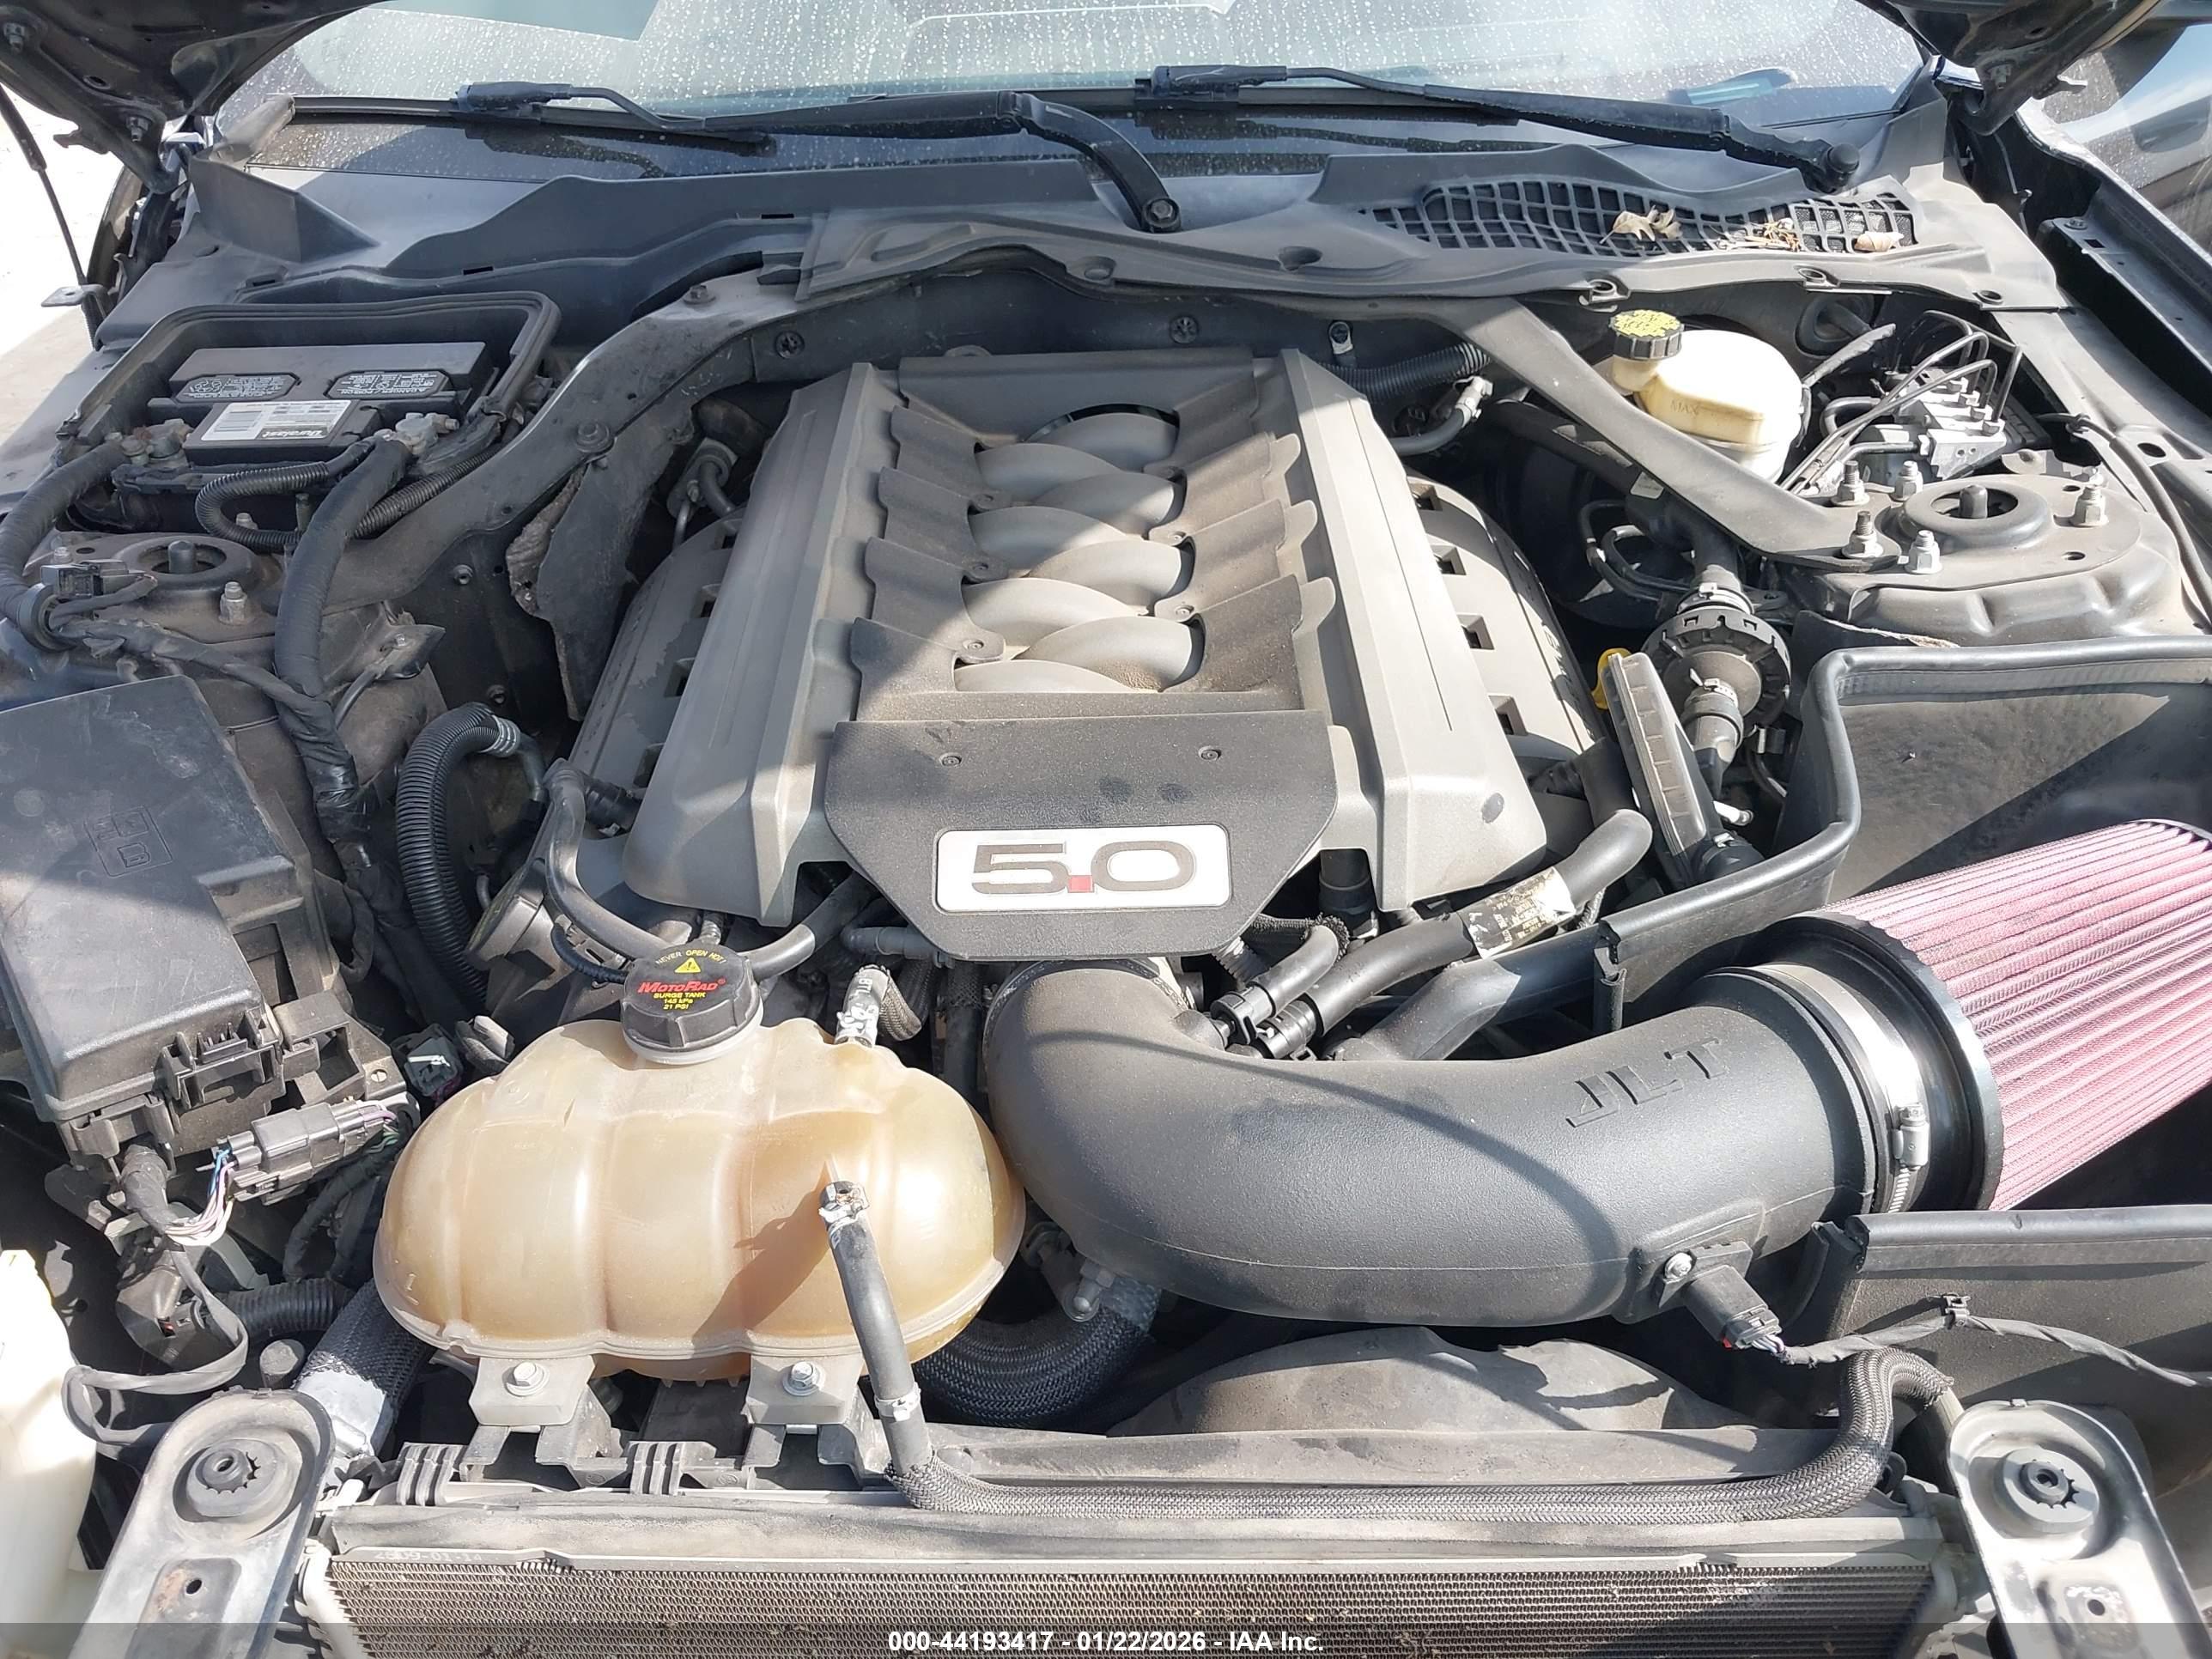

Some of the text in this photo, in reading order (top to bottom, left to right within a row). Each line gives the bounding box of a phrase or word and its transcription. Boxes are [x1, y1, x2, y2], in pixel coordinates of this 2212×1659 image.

[1670, 399, 1699, 416] MAX
[261, 429, 322, 439] Duralast
[972, 840, 1195, 895] 5.0
[655, 951, 682, 964] NEVER
[1565, 1038, 1730, 1128] JLT
